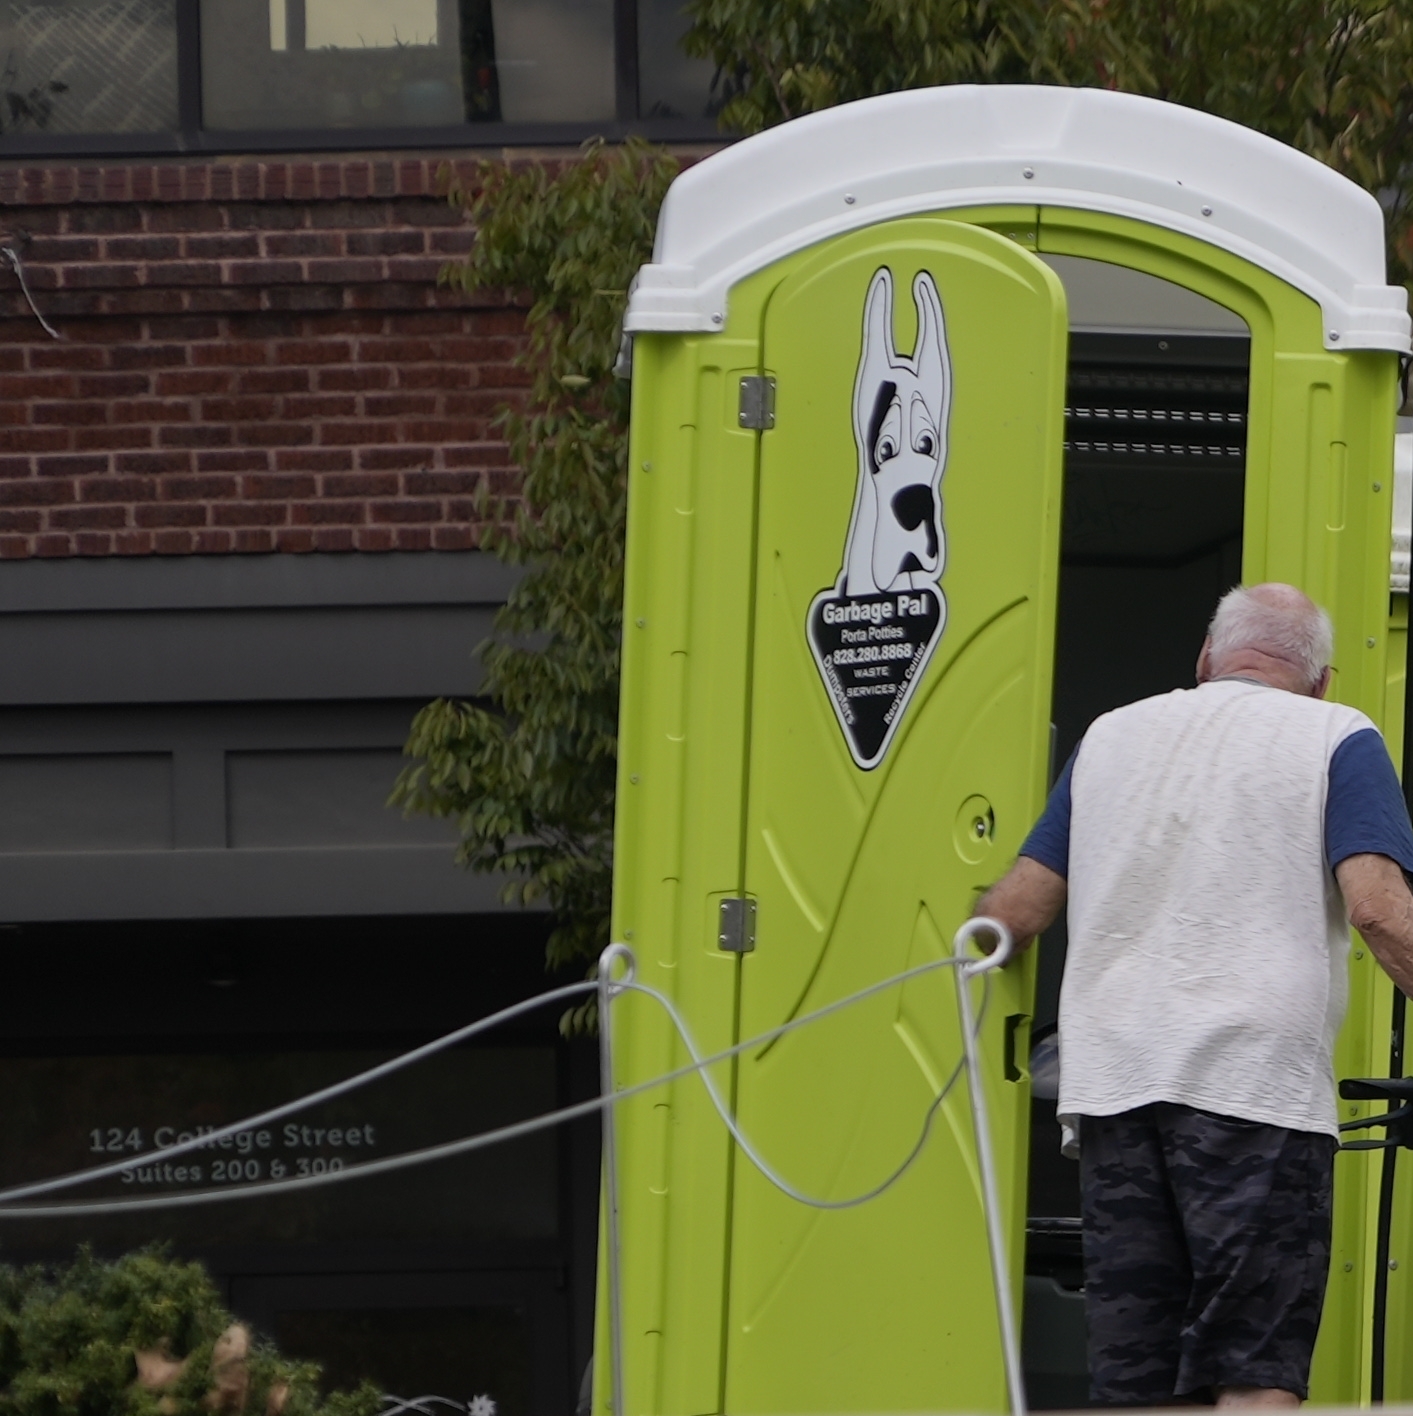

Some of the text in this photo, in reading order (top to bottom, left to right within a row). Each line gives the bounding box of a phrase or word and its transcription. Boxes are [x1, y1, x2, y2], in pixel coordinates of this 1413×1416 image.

[823, 594, 926, 624] Garbage Pal
[841, 626, 904, 643] Porta Potties
[833, 643, 913, 665] 828.280.8868
[853, 666, 889, 677] WASTE
[846, 684, 895, 697] SERVICES
[90, 1128, 141, 1153] 124
[282, 1123, 375, 1147] Street
[121, 1157, 344, 1184] Suites 200 & 300
